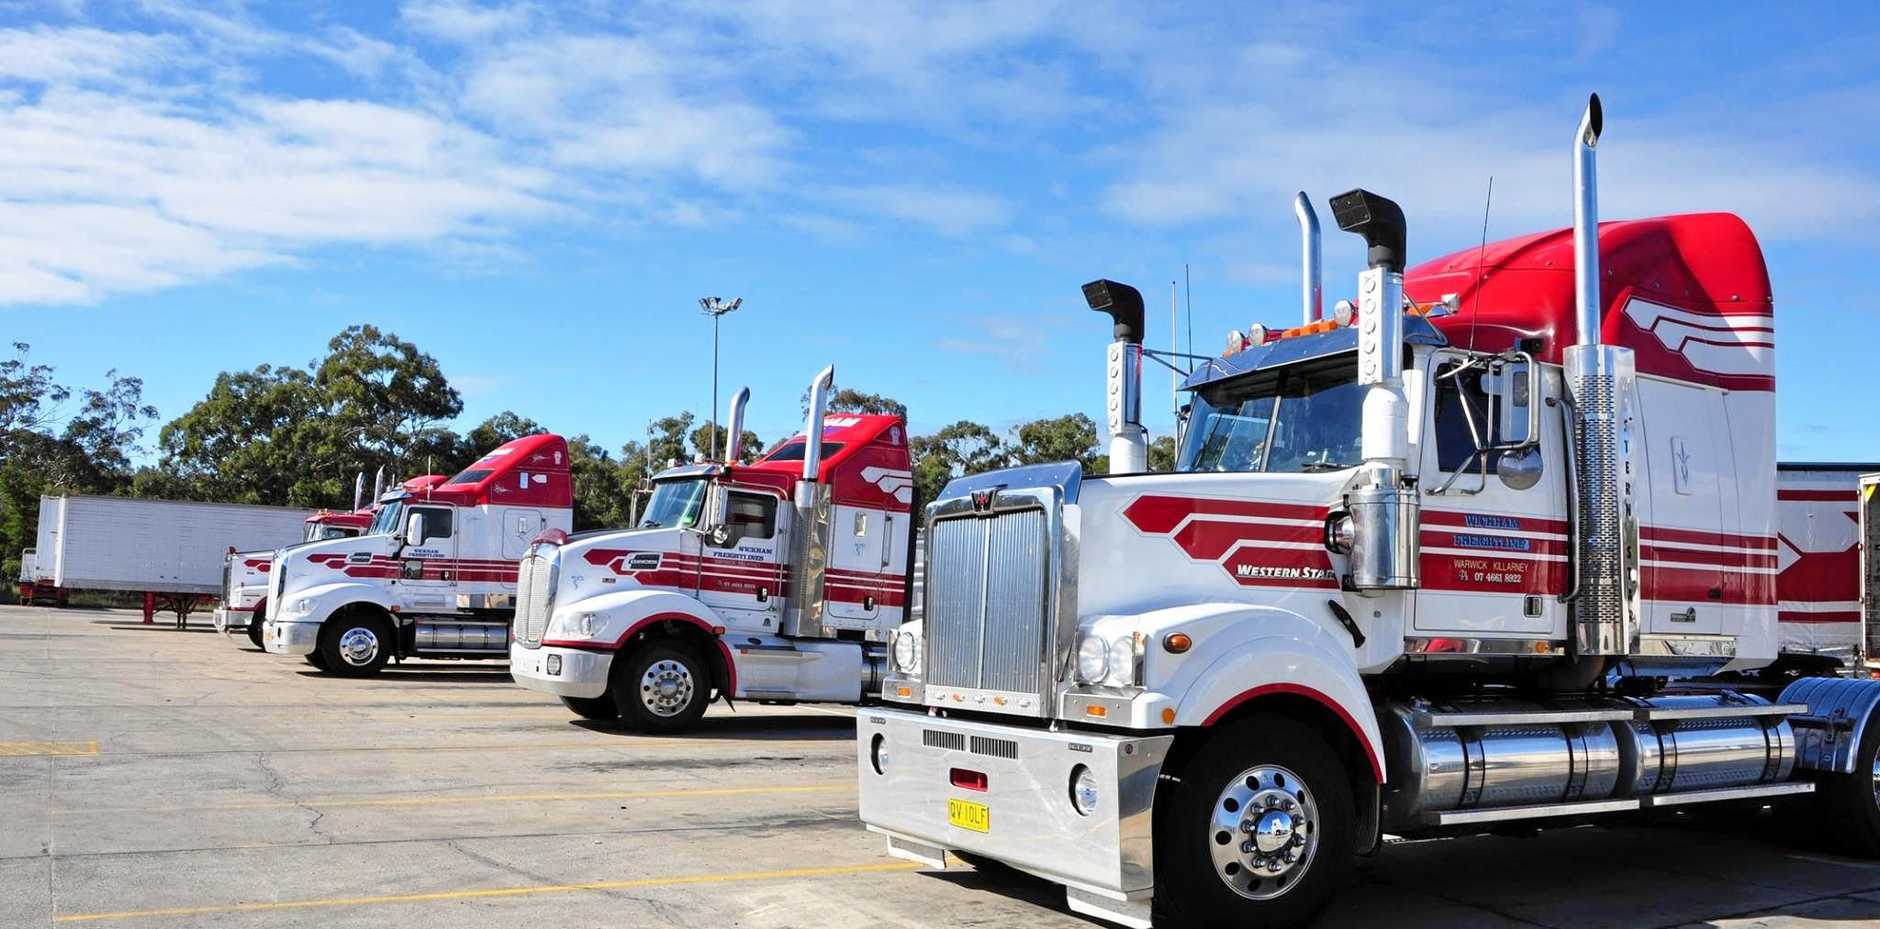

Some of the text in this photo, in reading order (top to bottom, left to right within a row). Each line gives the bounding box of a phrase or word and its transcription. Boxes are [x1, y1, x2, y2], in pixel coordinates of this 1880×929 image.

[1453, 559, 1488, 570] WARWICK
[1492, 561, 1529, 573] KILLARNEY
[1236, 564, 1336, 580] WESTERN STAR
[1474, 571, 1484, 582] 07
